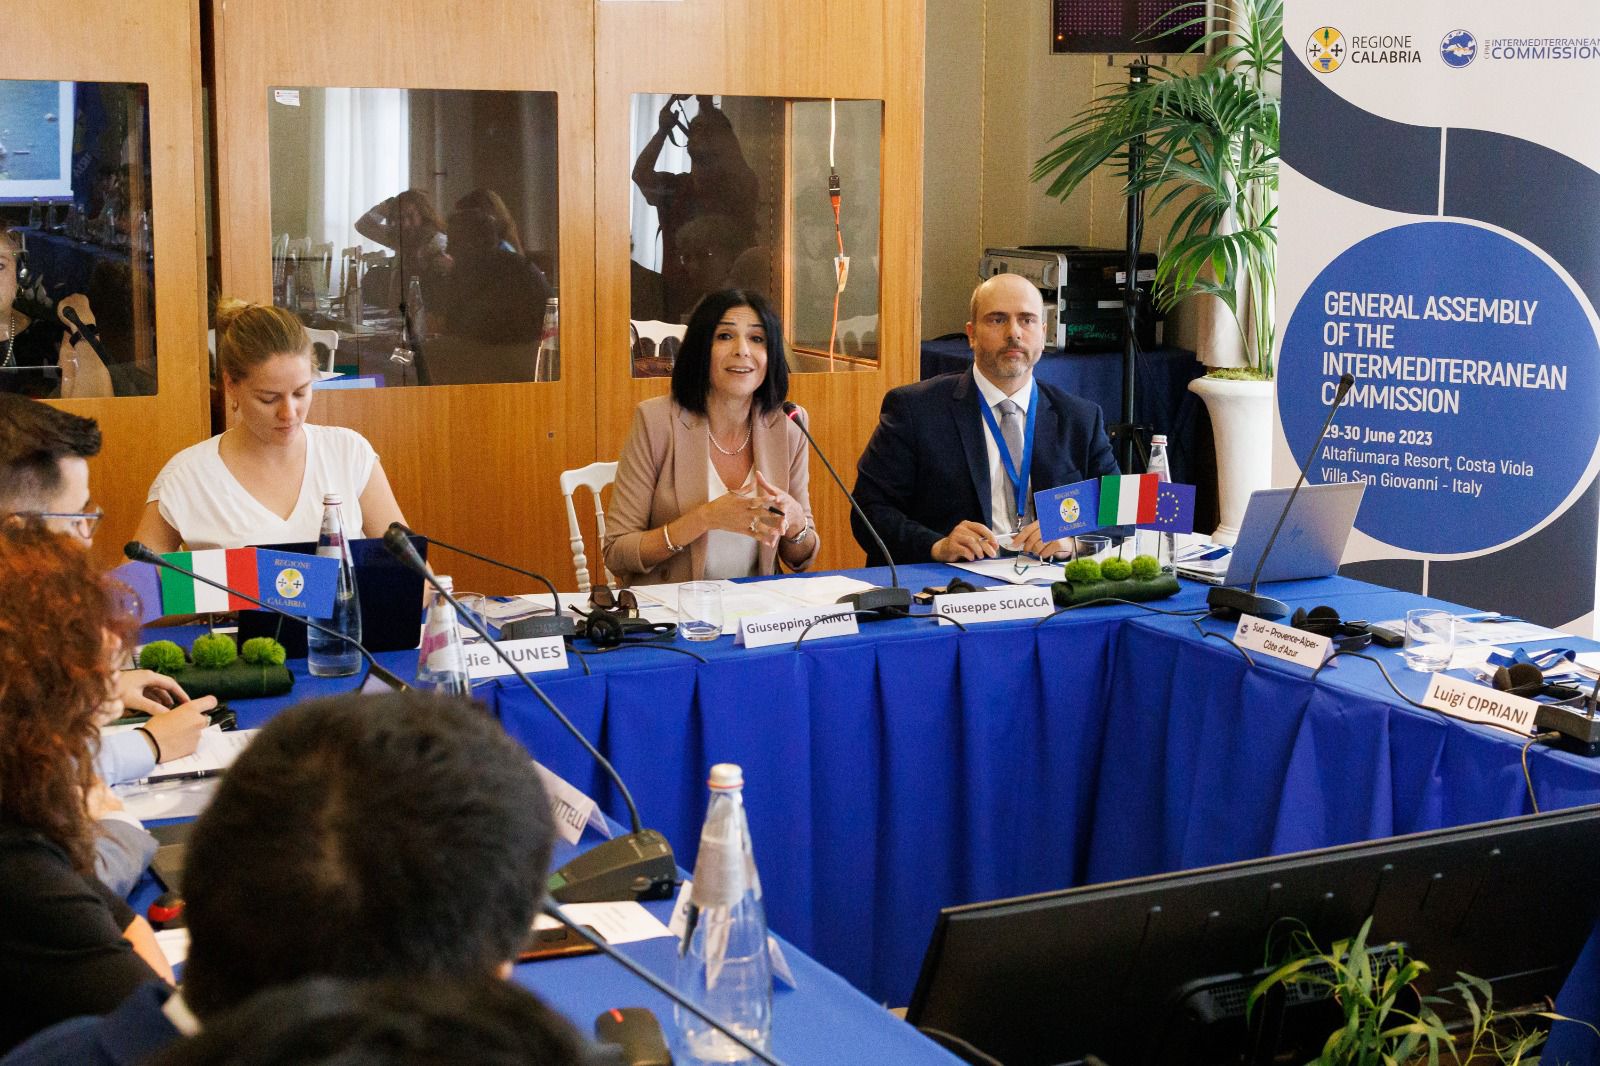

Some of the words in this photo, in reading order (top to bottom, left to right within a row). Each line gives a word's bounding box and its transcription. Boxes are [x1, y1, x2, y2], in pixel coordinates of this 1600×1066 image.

[1352, 35, 1412, 49] REGIONE
[1491, 46, 1600, 60] COMMISSION
[1351, 50, 1422, 64] CALABRIA
[1324, 290, 1420, 320] GENERAL
[1423, 295, 1539, 326] ASSEMBLY
[1323, 321, 1351, 346] OF
[1354, 323, 1395, 349] THE
[1322, 351, 1568, 391] INTERMEDITERRANEAN
[1322, 424, 1361, 441] 29-30
[1362, 427, 1396, 444] June
[1398, 429, 1433, 446] 2023
[1321, 445, 1400, 466] Altafiumara
[1404, 452, 1452, 473] Resort,
[1456, 456, 1496, 474] Costa
[1500, 459, 1534, 477] Viola
[1321, 467, 1348, 483] Villa
[1351, 469, 1377, 486] San
[1380, 472, 1438, 491] Giovanni
[1452, 478, 1483, 498] Italy
[941, 602, 997, 615] Giuseppe
[999, 597, 1050, 610] SCIACCA
[746, 615, 811, 635] Giuseppina
[814, 611, 853, 626] PRINCI
[1252, 622, 1266, 634] Sud
[1433, 685, 1466, 708] Luigi
[1467, 695, 1529, 725] CIPRIANI
